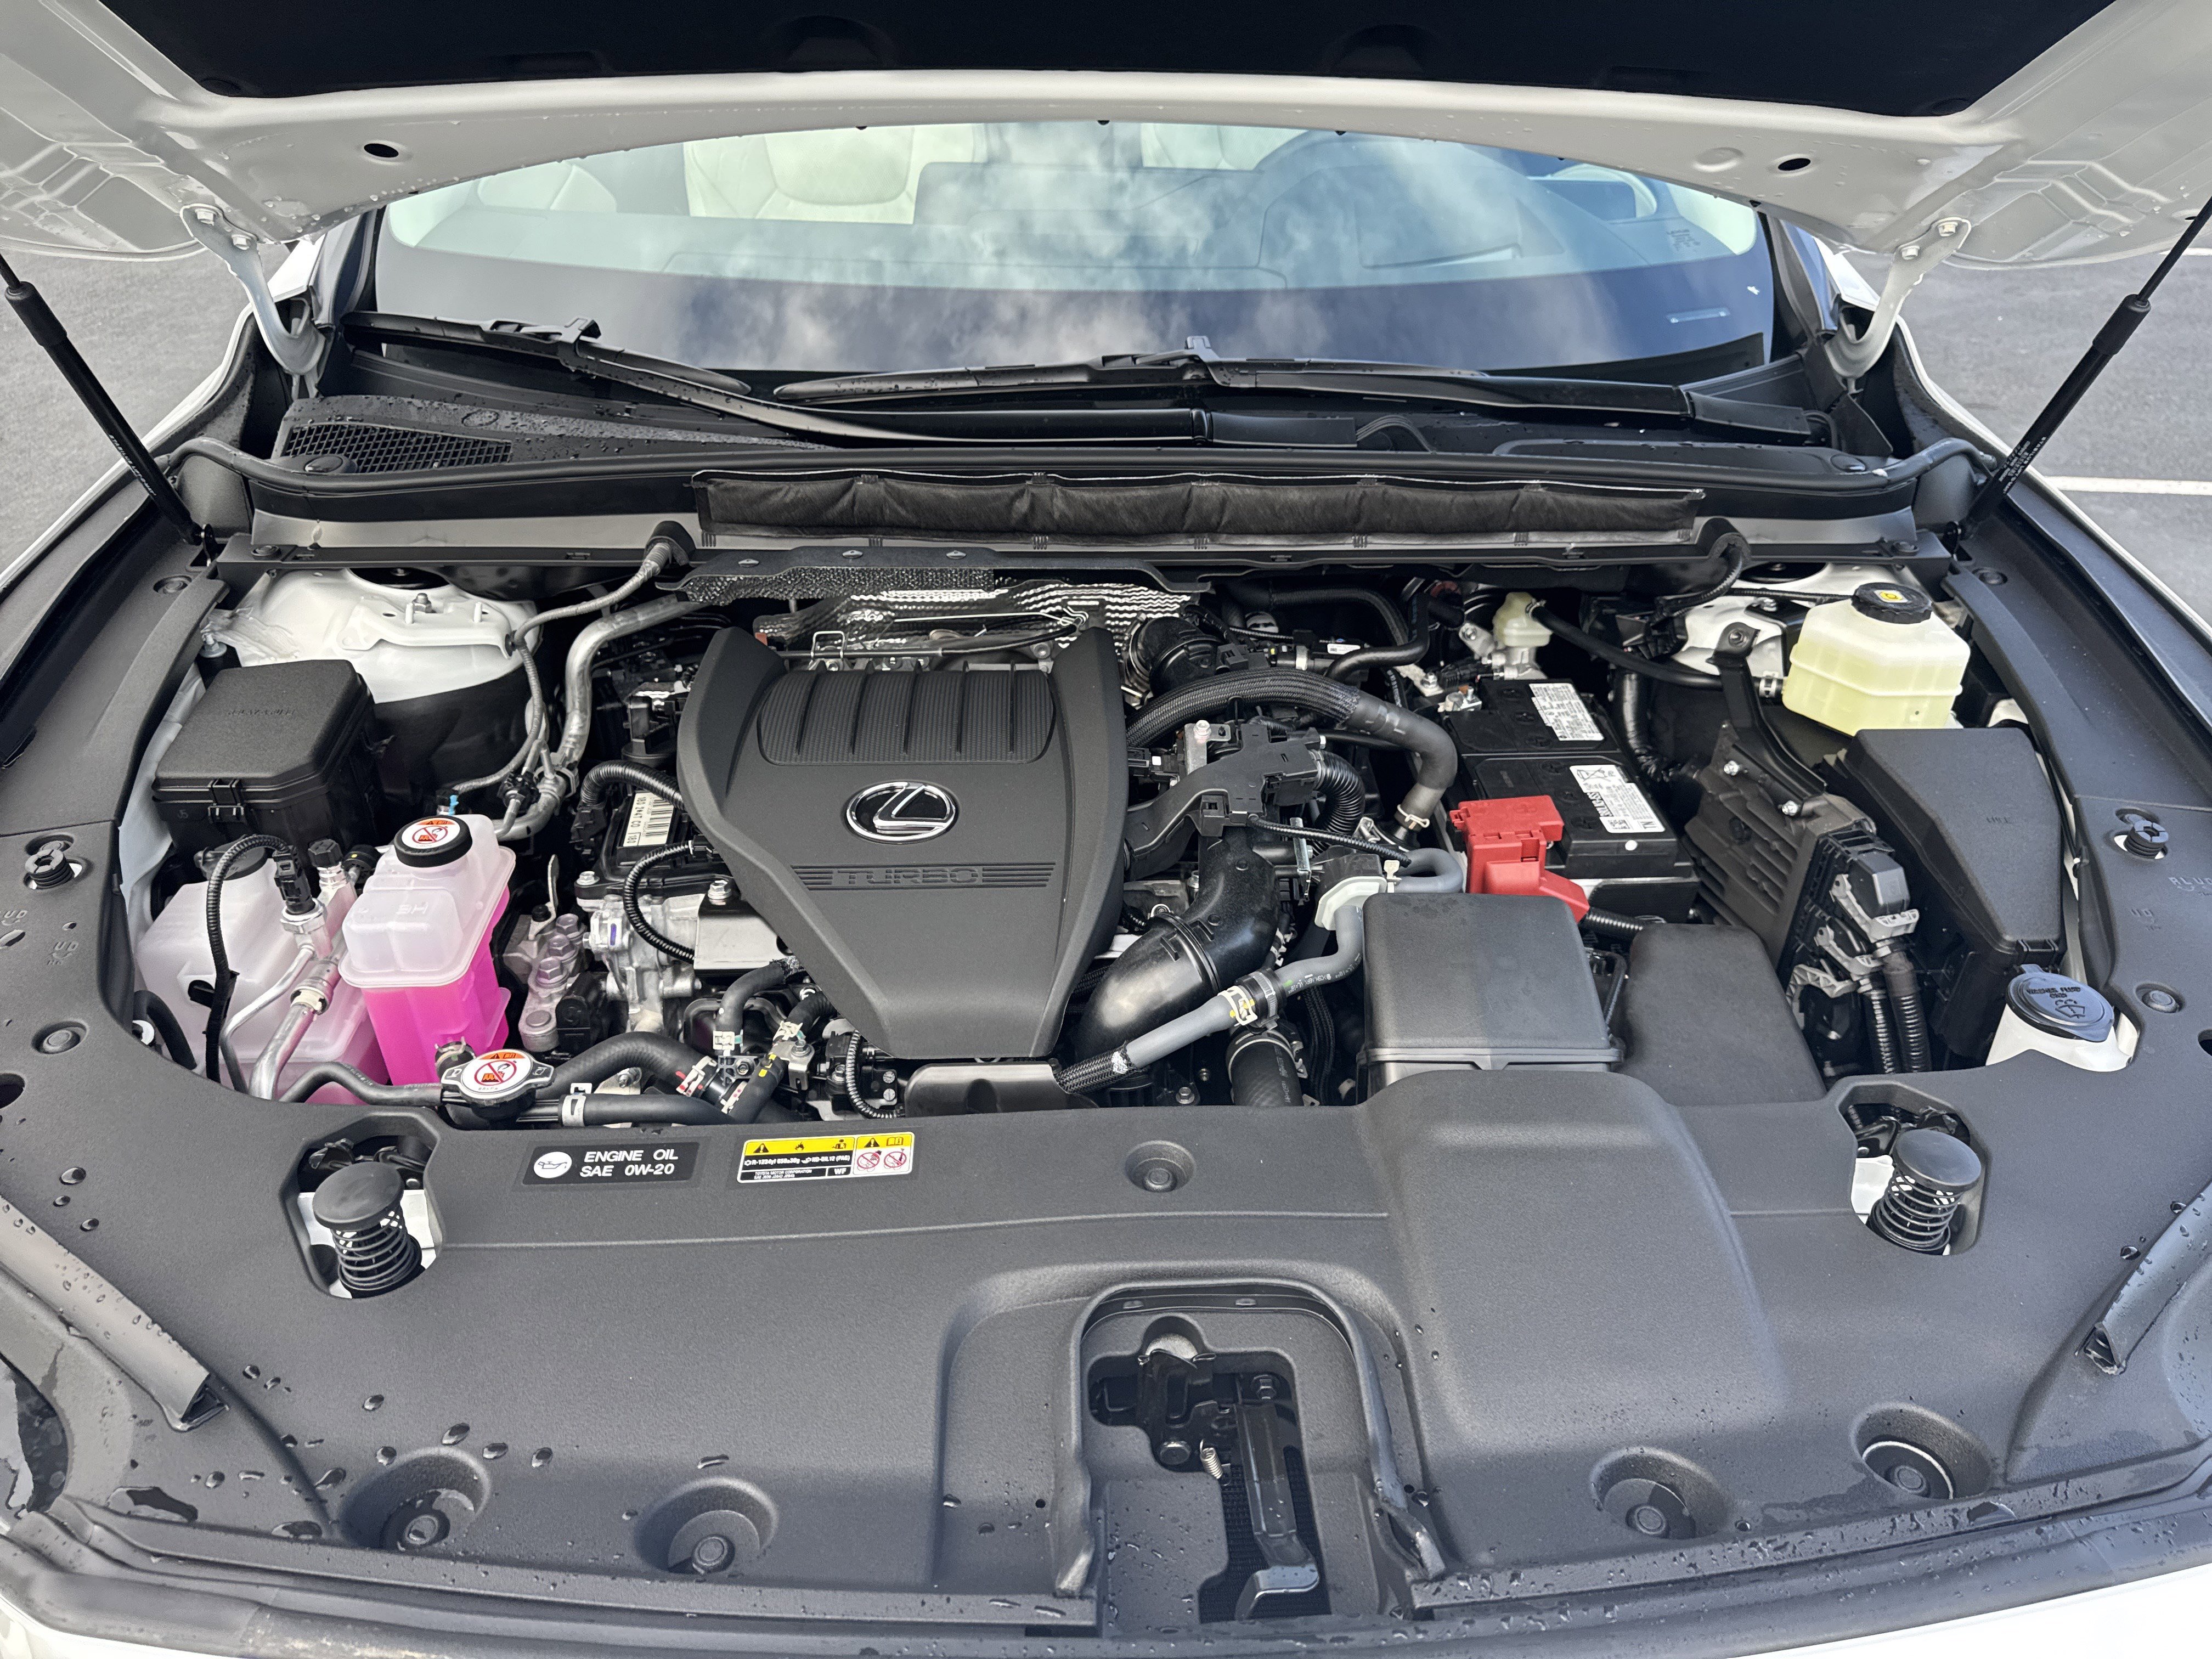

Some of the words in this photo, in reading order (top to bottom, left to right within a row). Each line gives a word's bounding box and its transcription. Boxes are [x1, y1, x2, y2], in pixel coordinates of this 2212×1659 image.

[838, 867, 979, 884] TURBO
[584, 1150, 644, 1163] ENGINE
[653, 1149, 679, 1161] OIL
[579, 1165, 614, 1177] SAE
[624, 1163, 675, 1176] 0W-20
